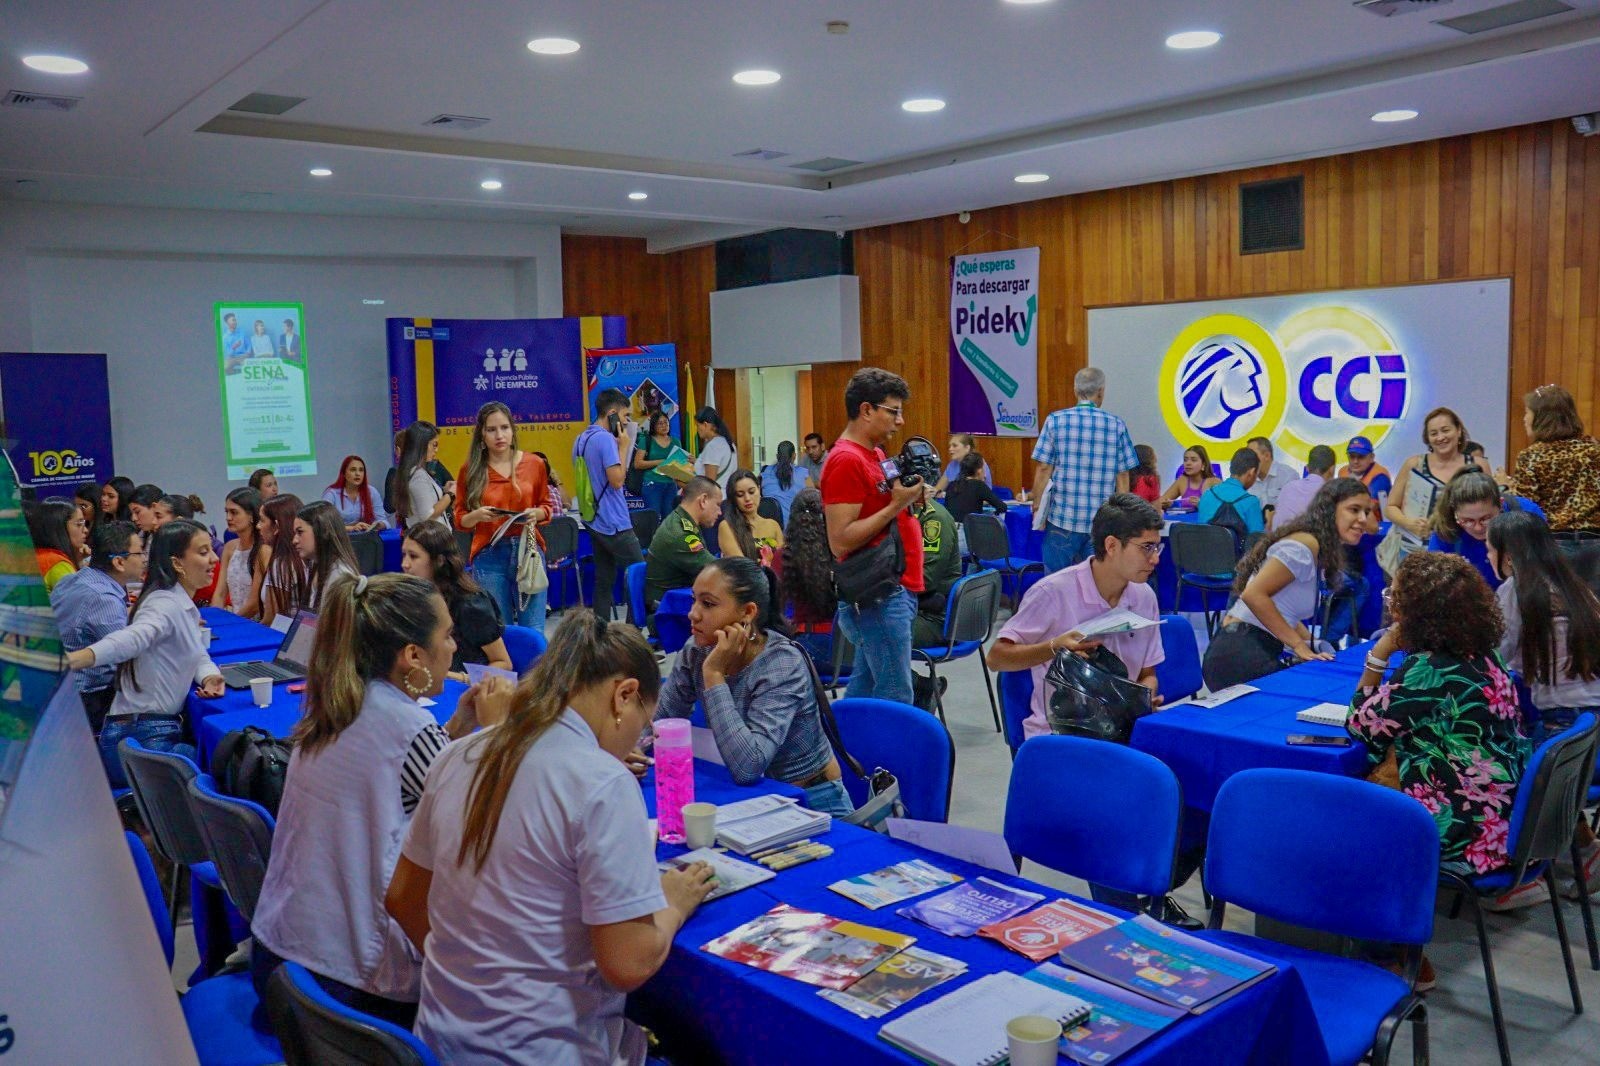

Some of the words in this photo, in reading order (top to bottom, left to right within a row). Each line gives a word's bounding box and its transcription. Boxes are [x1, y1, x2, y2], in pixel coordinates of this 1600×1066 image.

[956, 258, 978, 277] ¿Qué
[979, 258, 1015, 274] esperas
[956, 281, 978, 296] Para
[979, 278, 1030, 296] descargar
[956, 294, 1037, 346] Pideky
[243, 365, 285, 380] SENA
[495, 381, 507, 389] DE
[506, 380, 539, 389] EMPLEO
[529, 413, 571, 421] TALENTO
[446, 428, 457, 436] DE
[64, 456, 95, 468] Años
[967, 890, 1017, 909] DELITO
[887, 954, 939, 979] ABC
